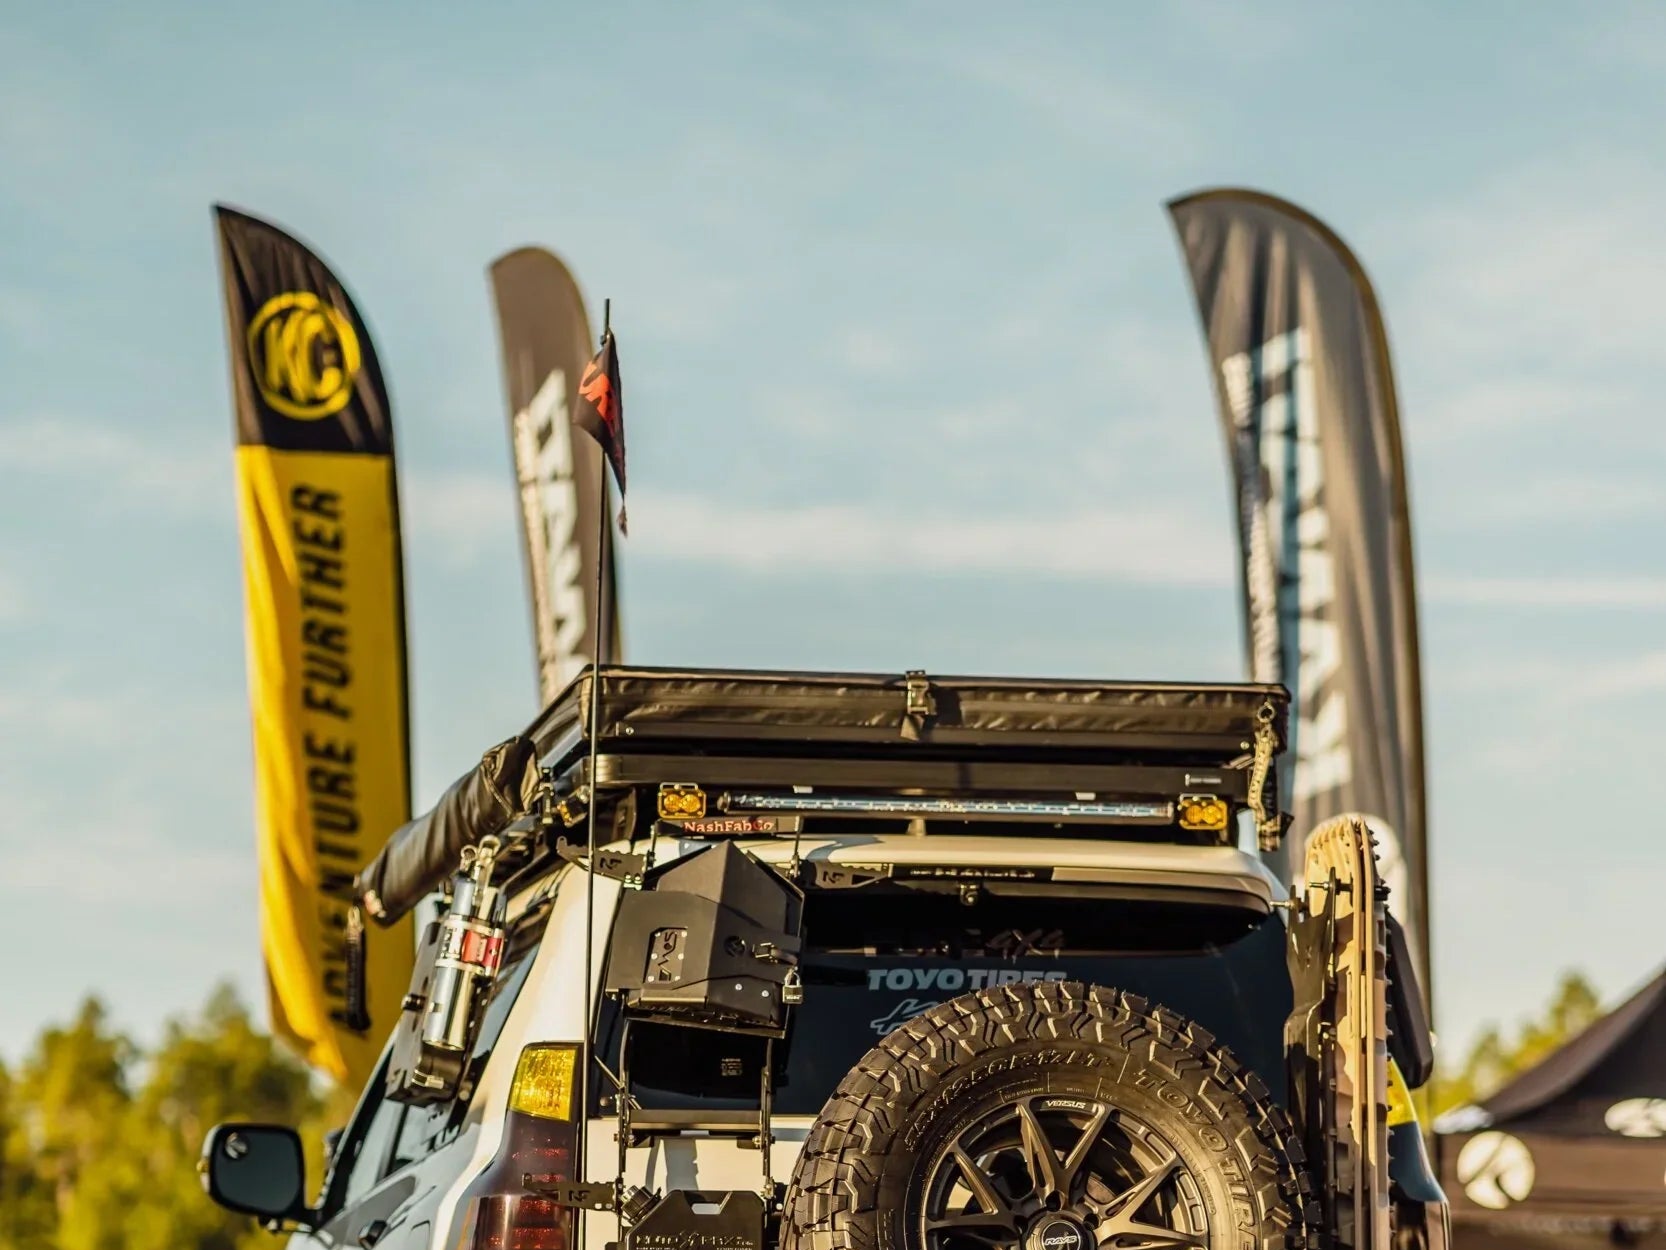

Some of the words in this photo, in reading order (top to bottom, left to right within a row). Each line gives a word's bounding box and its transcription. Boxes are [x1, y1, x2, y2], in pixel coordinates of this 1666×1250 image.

[264, 310, 342, 402] KC
[291, 484, 352, 720] FURTHER
[1045, 1100, 1087, 1110] VERSUS
[1135, 1068, 1229, 1152] TOYO
[1044, 1235, 1078, 1246] RAYS
